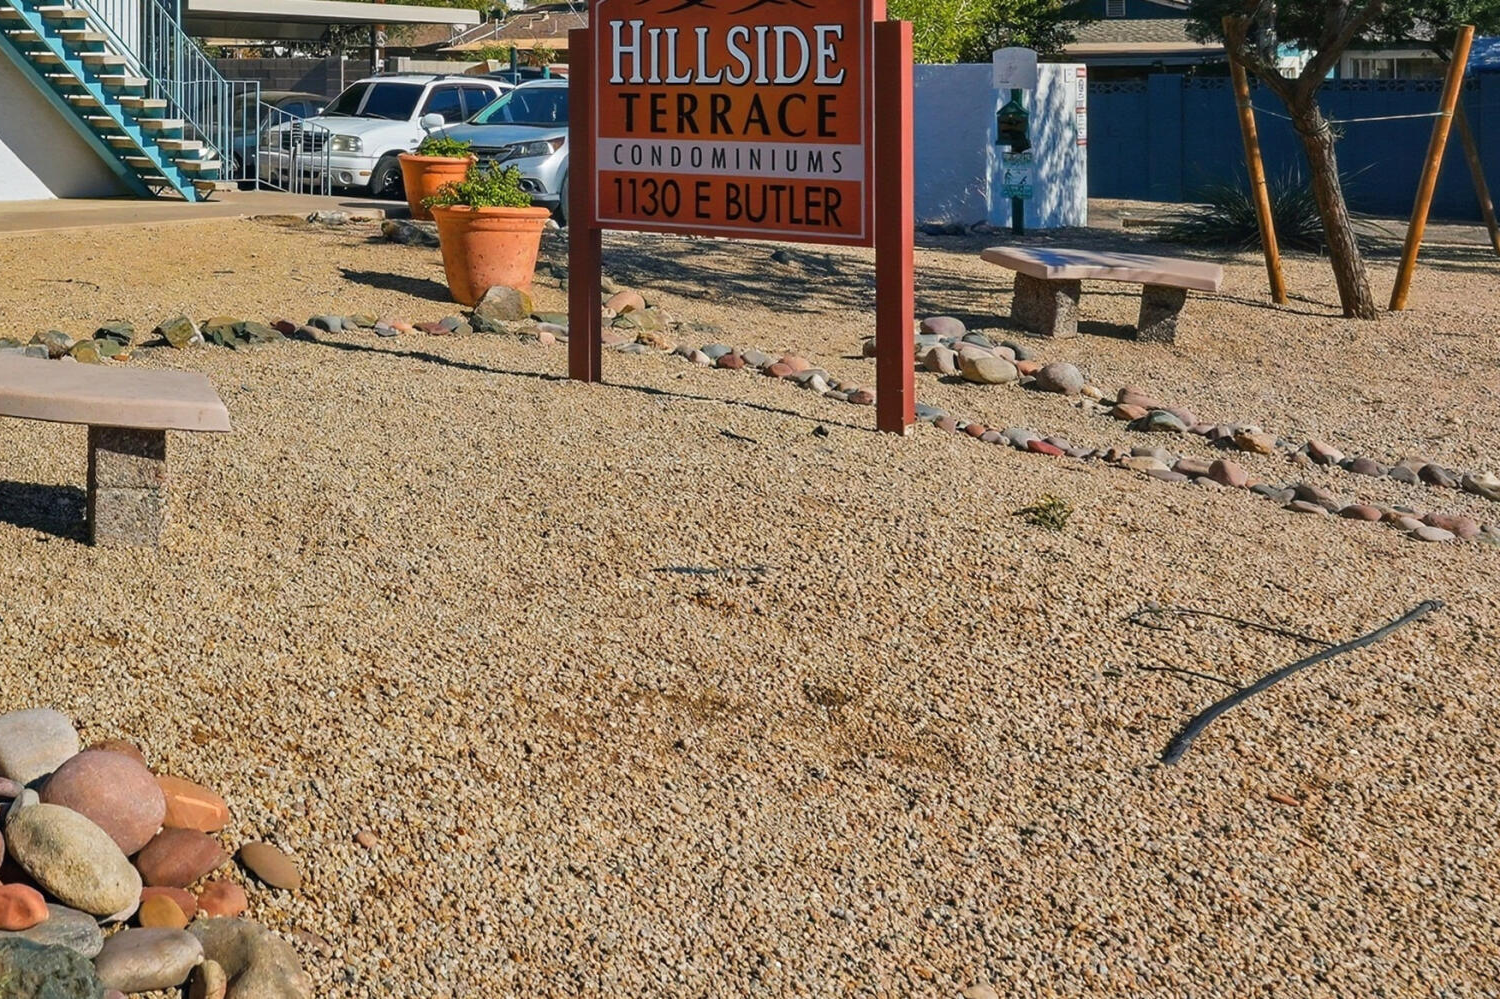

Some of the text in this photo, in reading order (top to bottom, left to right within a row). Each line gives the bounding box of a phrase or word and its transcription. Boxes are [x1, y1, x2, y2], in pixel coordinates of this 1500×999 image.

[609, 19, 845, 85] HILLSIDE
[618, 92, 838, 138] TERRACE
[613, 143, 843, 174] CONDOMINIUMS
[613, 177, 843, 228] 1130 E BUTLER
